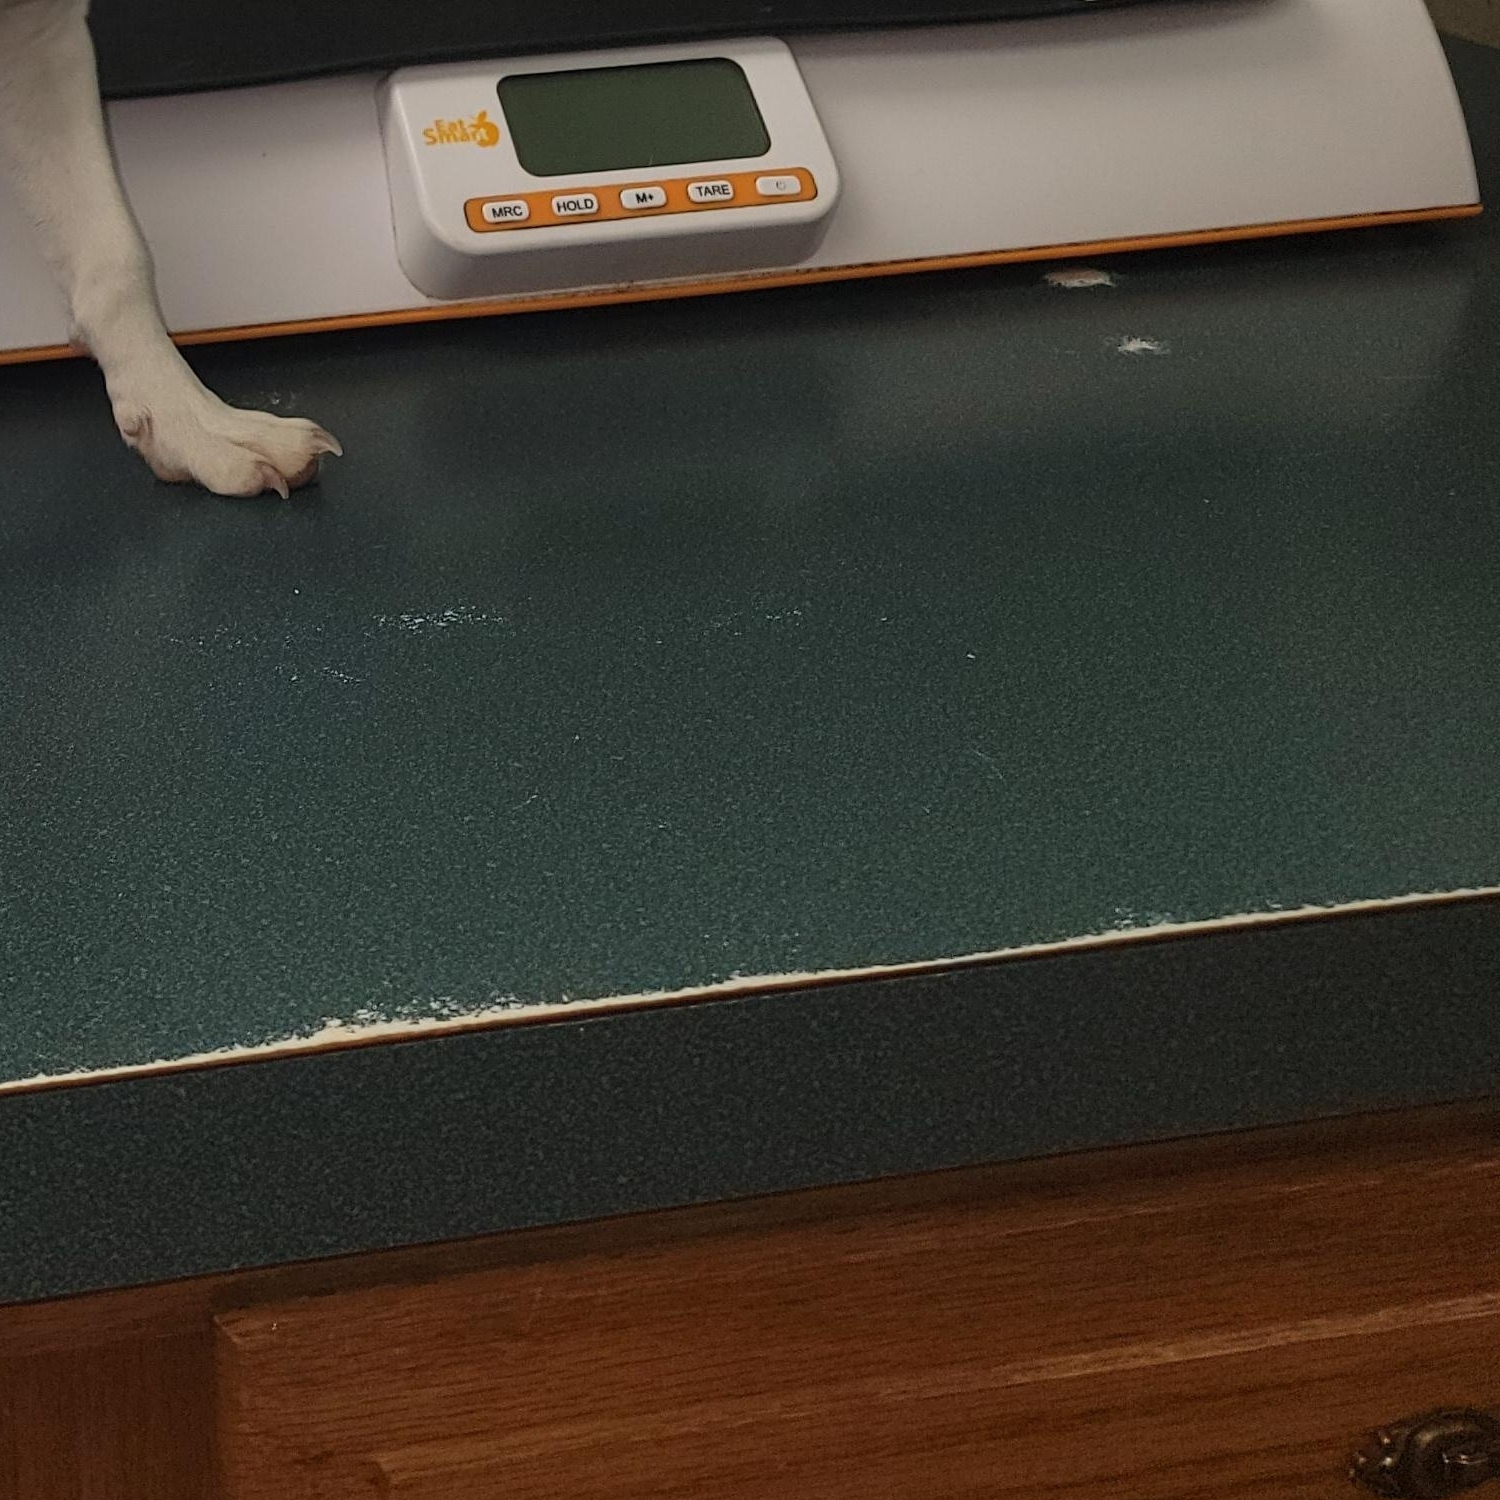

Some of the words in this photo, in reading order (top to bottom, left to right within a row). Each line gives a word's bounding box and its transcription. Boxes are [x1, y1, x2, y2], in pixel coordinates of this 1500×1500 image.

[696, 184, 730, 197] TARE
[636, 192, 654, 204] M+
[557, 198, 594, 213] HOLD
[492, 206, 524, 219] MRC
